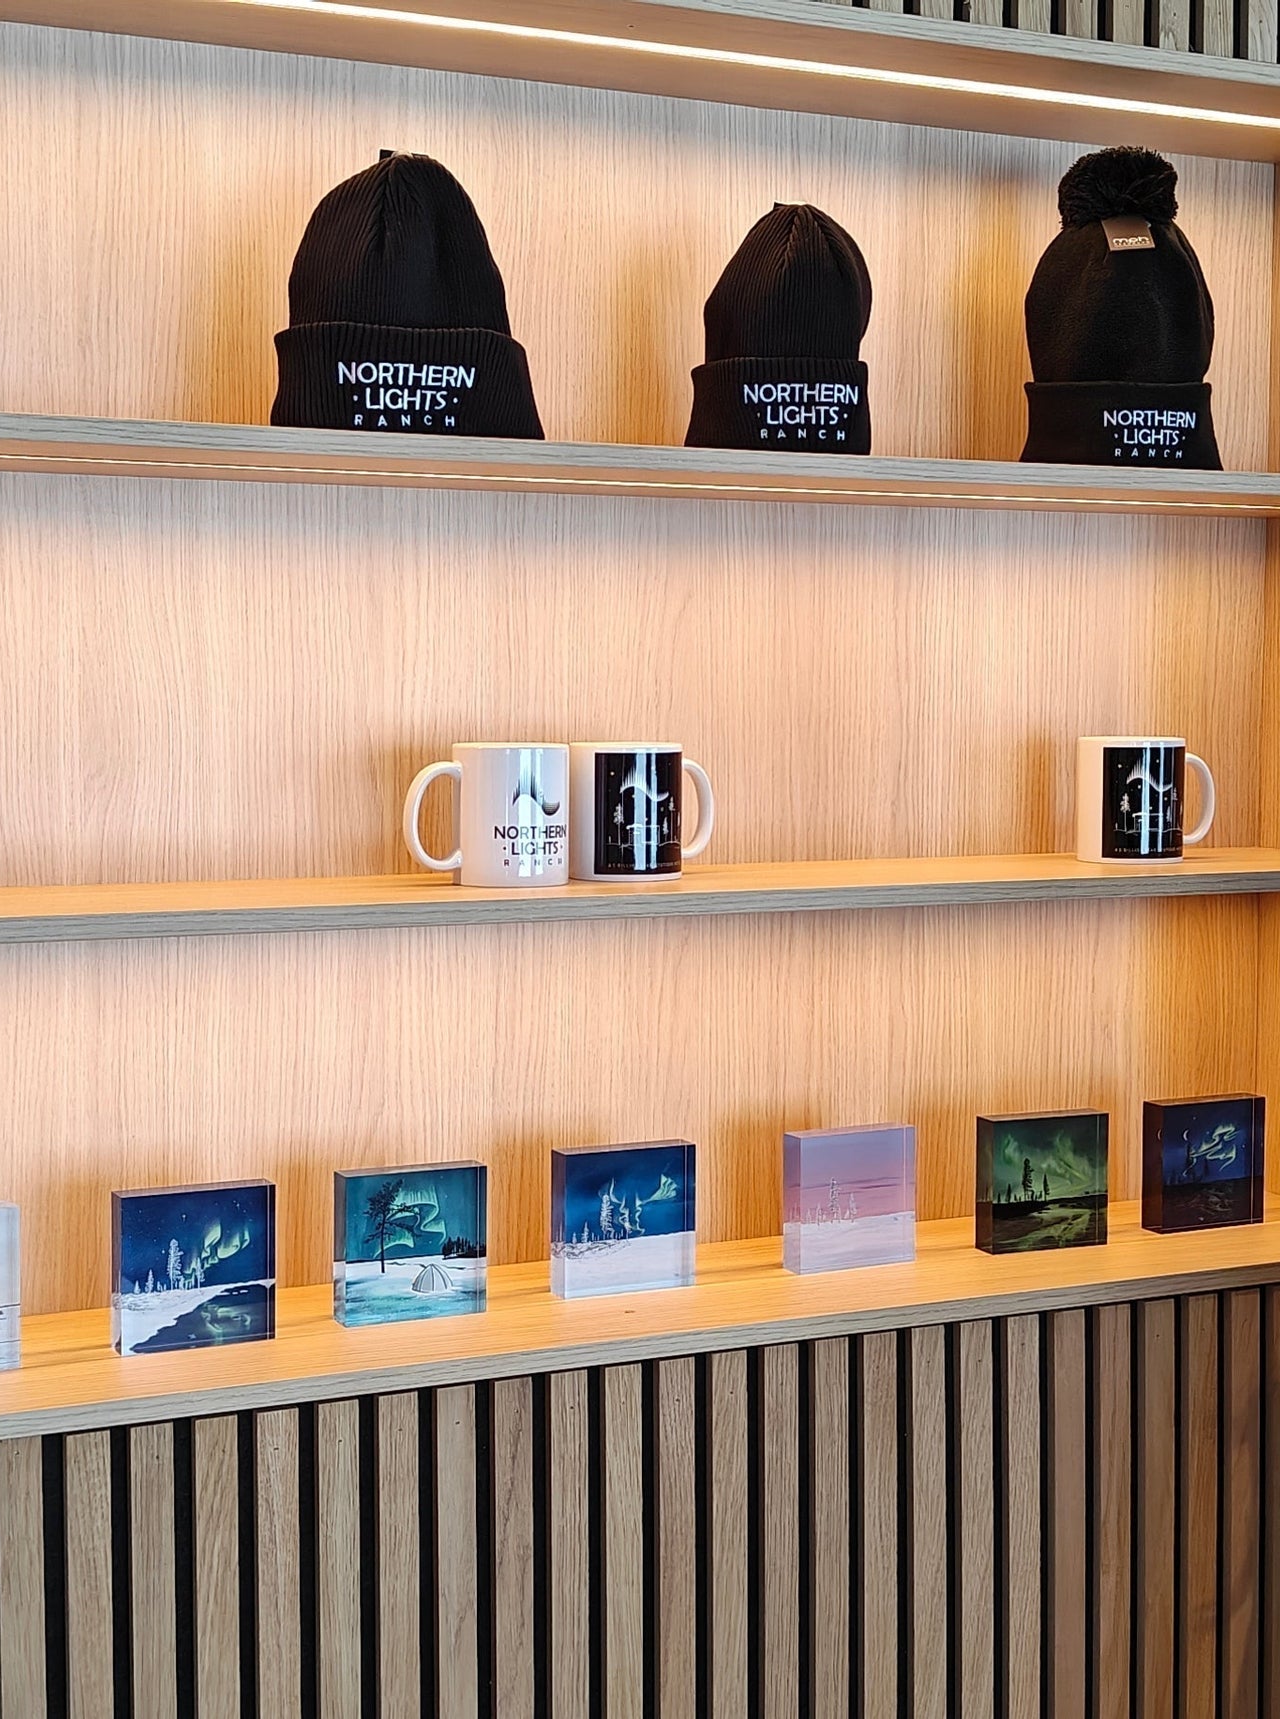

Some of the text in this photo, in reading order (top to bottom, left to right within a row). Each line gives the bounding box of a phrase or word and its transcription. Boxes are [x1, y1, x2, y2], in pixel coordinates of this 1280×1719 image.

[337, 361, 476, 389] NORTHERN
[365, 387, 448, 411] LIGHTS
[743, 383, 859, 405] NORTHERN
[354, 414, 456, 427] RANCH
[766, 405, 840, 425] LIGHTS
[1103, 409, 1197, 429] NORTHERN
[760, 428, 846, 441] RANCH
[1123, 428, 1180, 446] LIGHTS
[1114, 448, 1183, 459] RANCH
[494, 824, 567, 840] NORTHERN
[511, 841, 559, 856] LIGHTS
[503, 857, 563, 867] RANCH
